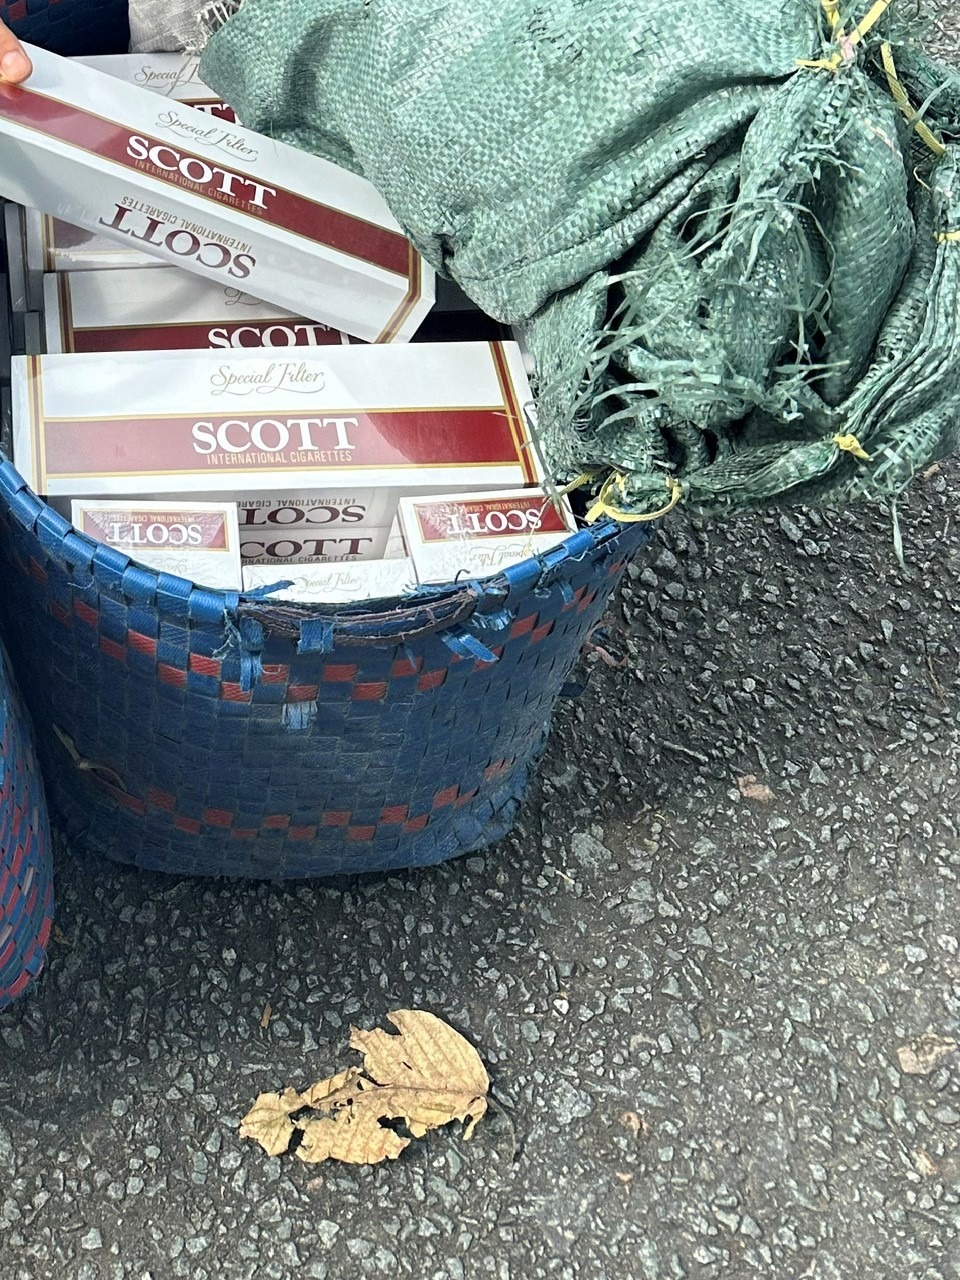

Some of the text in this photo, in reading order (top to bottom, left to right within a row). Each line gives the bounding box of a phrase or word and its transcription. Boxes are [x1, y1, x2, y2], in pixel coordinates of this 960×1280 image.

[155, 111, 215, 140] Special
[195, 129, 259, 162] Filter
[126, 135, 276, 209] SCOTT
[134, 159, 263, 215] INTERNATIONAL CIGARETTES
[122, 196, 252, 253] INTERNATIONAL CIGARETTES
[99, 203, 257, 279] SCOTT
[210, 362, 326, 396] Special Filter
[192, 418, 358, 454] SCOTT
[207, 450, 352, 465] INTERNATIONAL CIGARETTES
[239, 505, 366, 526] SCOT
[277, 498, 356, 507] INTERNATIONAL
[106, 522, 201, 544] SCOTT
[447, 509, 542, 534] SCOTT
[240, 538, 373, 559] COTT
[298, 555, 357, 563] CIGARETTES
